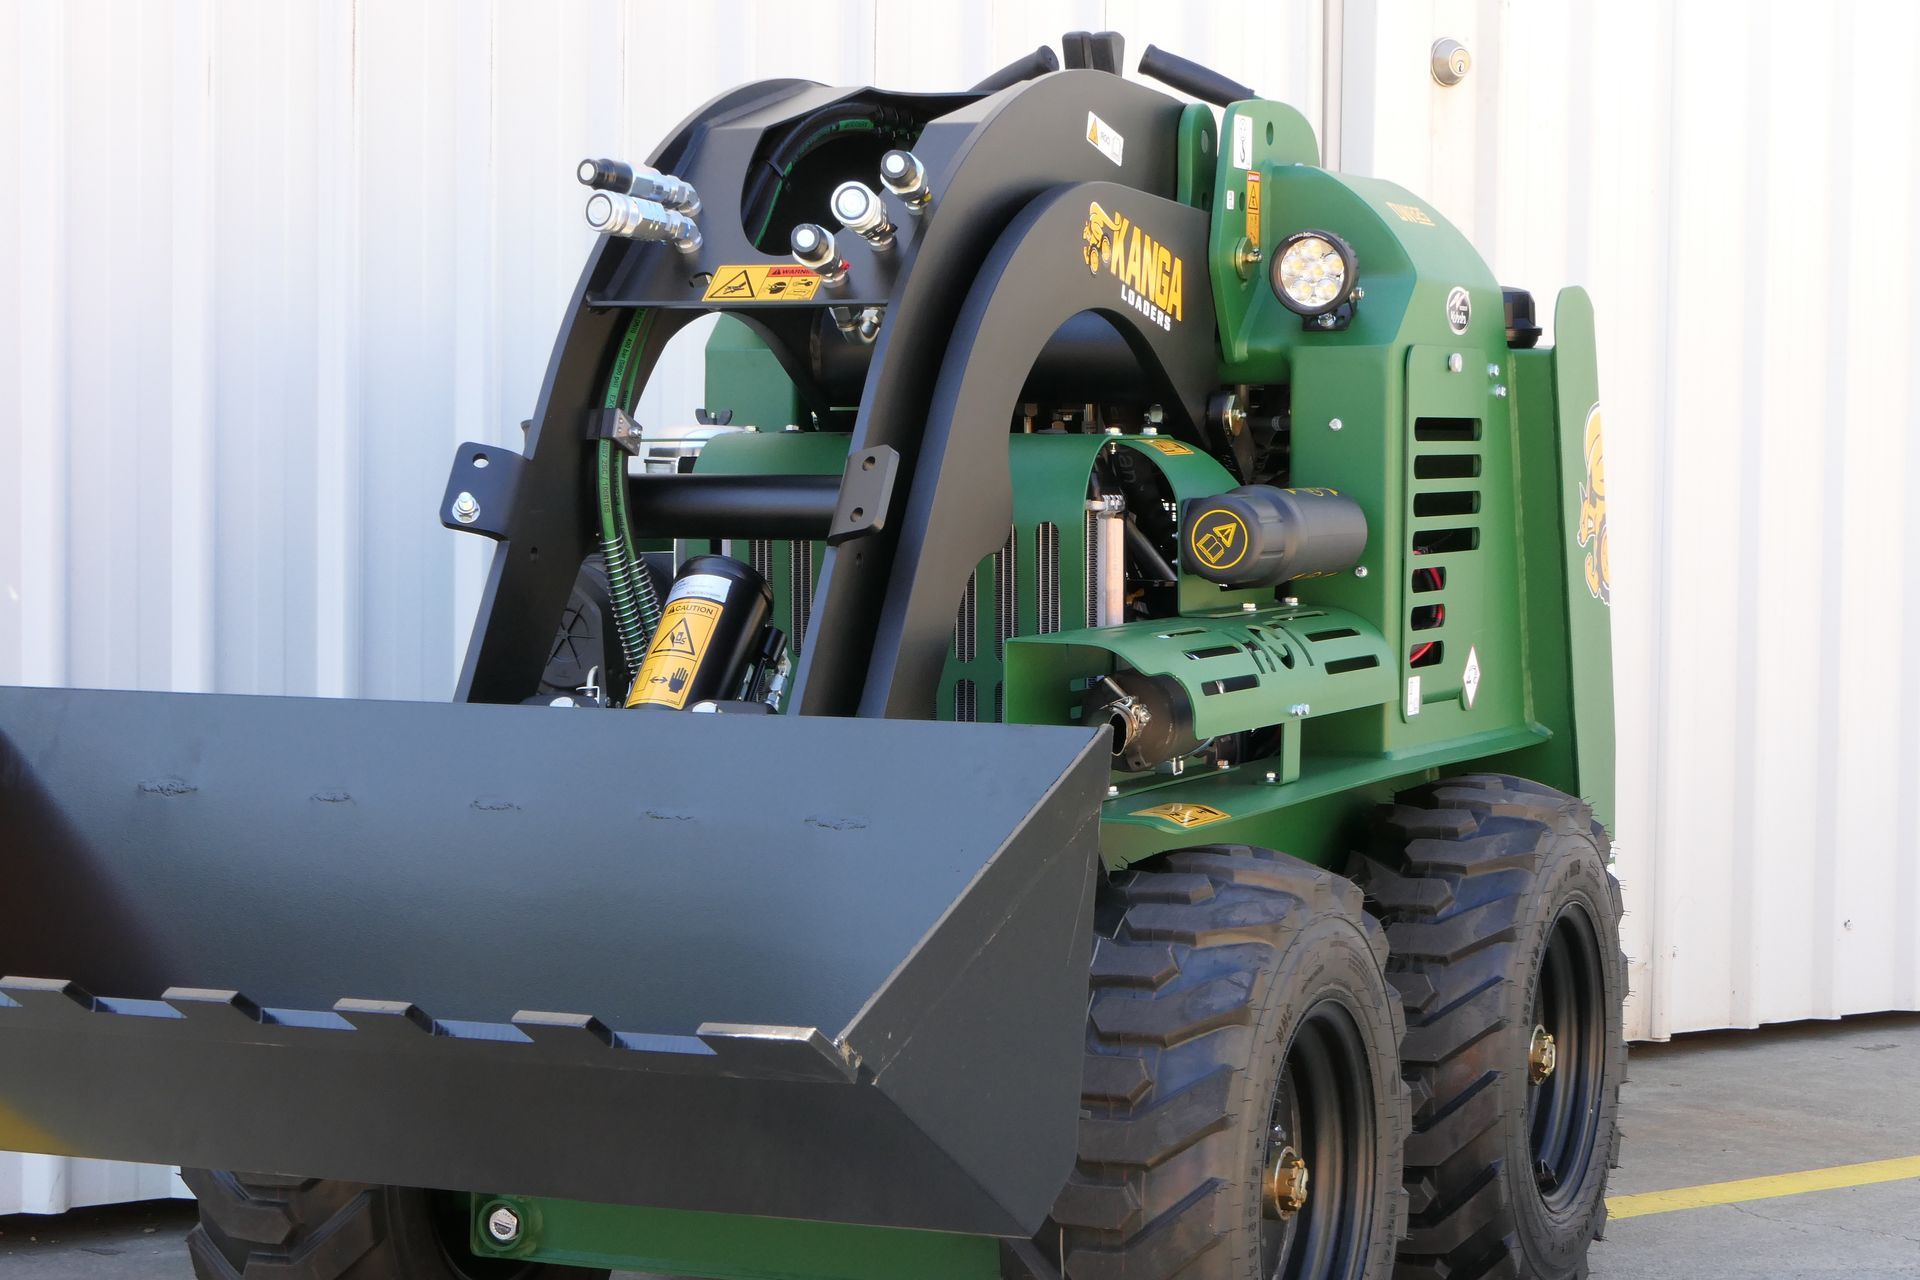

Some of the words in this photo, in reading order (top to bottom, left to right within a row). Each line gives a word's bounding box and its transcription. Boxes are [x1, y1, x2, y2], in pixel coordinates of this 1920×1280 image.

[1111, 211, 1182, 321] KANGA
[1120, 284, 1171, 332] LOADERS
[675, 605, 714, 616] CAUTION
